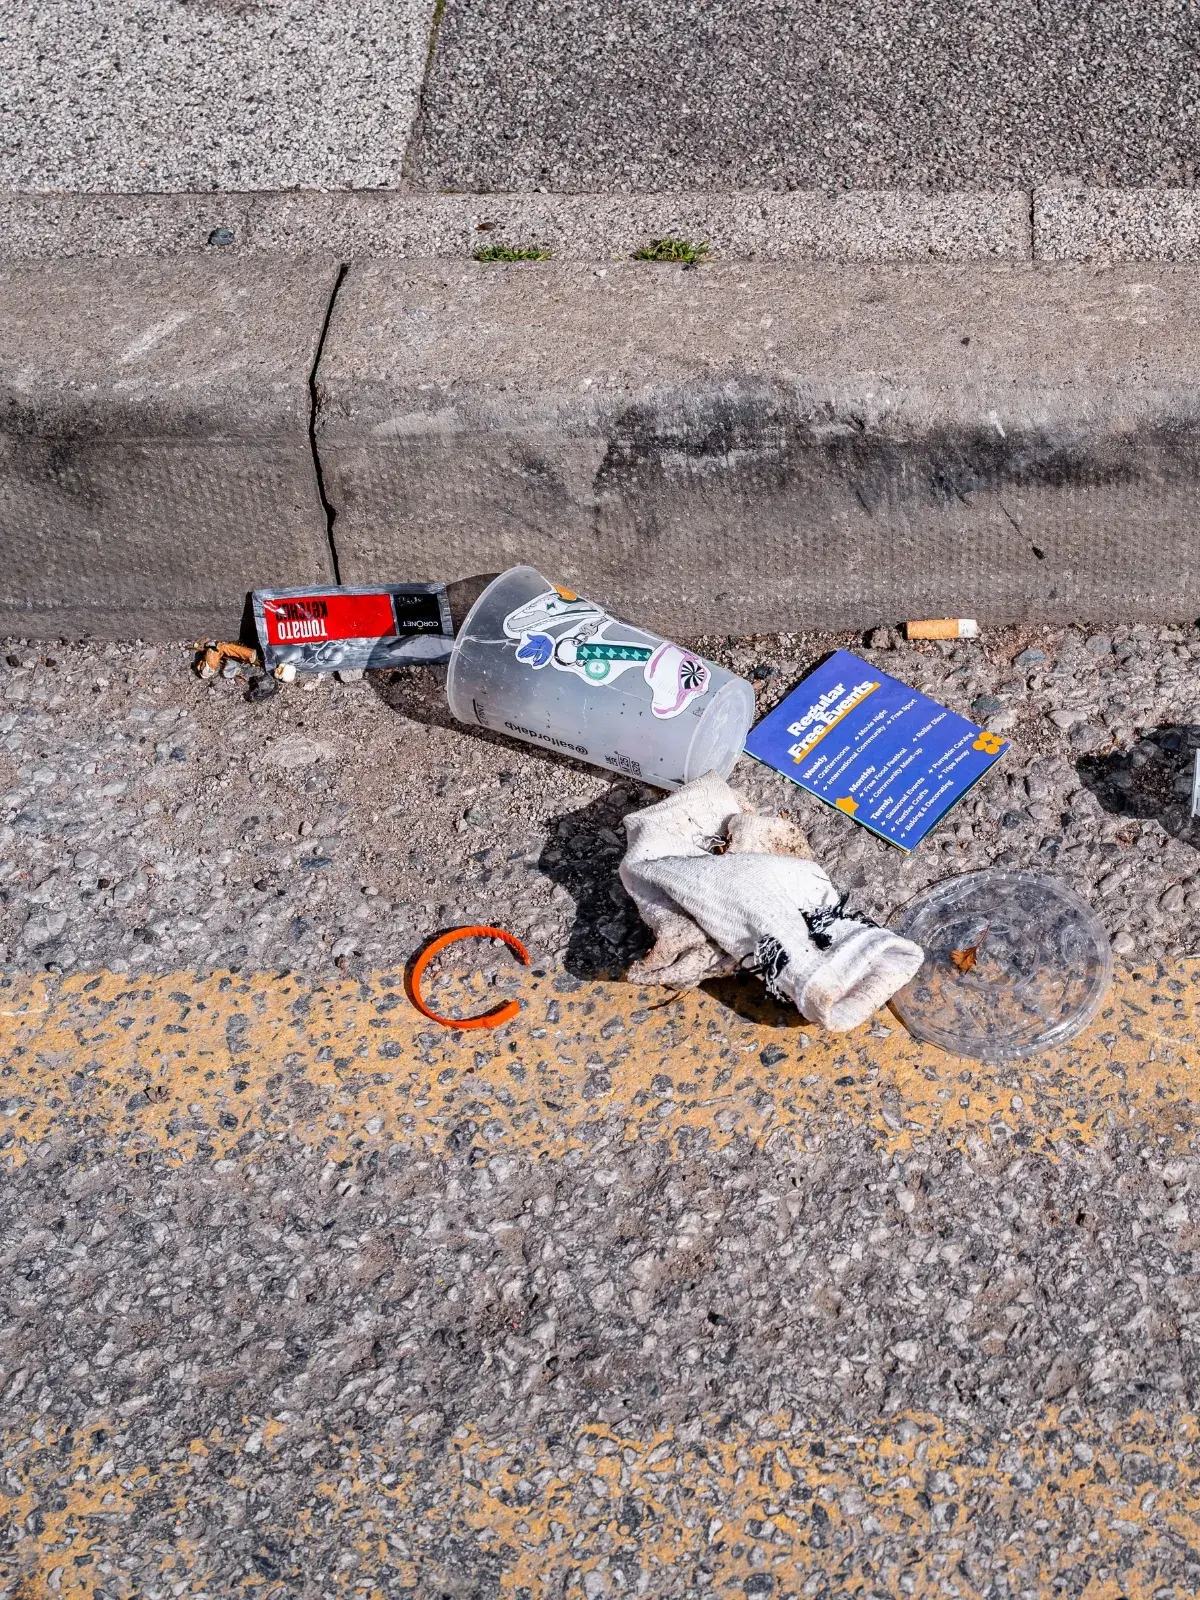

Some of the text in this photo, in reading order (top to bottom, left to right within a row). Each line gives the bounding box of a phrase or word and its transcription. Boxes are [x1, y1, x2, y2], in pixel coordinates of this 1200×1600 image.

[402, 620, 439, 628] CORONET
[786, 682, 846, 737] Regular
[787, 680, 874, 759] Free Events
[857, 709, 888, 737] Movie Night
[890, 698, 918, 721] Free Sport
[915, 712, 947, 738] Roller Disco
[802, 754, 828, 779] Weekly
[817, 745, 850, 779] Crafternoons
[826, 725, 886, 785] International Community
[931, 732, 975, 769] Pumpkin Carving
[941, 749, 970, 774] Trips Away
[848, 765, 876, 793] Monthly
[863, 747, 907, 792] Free Food Festival
[872, 747, 923, 798] Community Meet-up
[870, 796, 894, 819] Termly
[885, 777, 925, 819] Seasonal Events
[894, 788, 929, 825] Festive Crafts
[904, 810, 924, 831] Baking
[924, 779, 954, 807] Decorating
